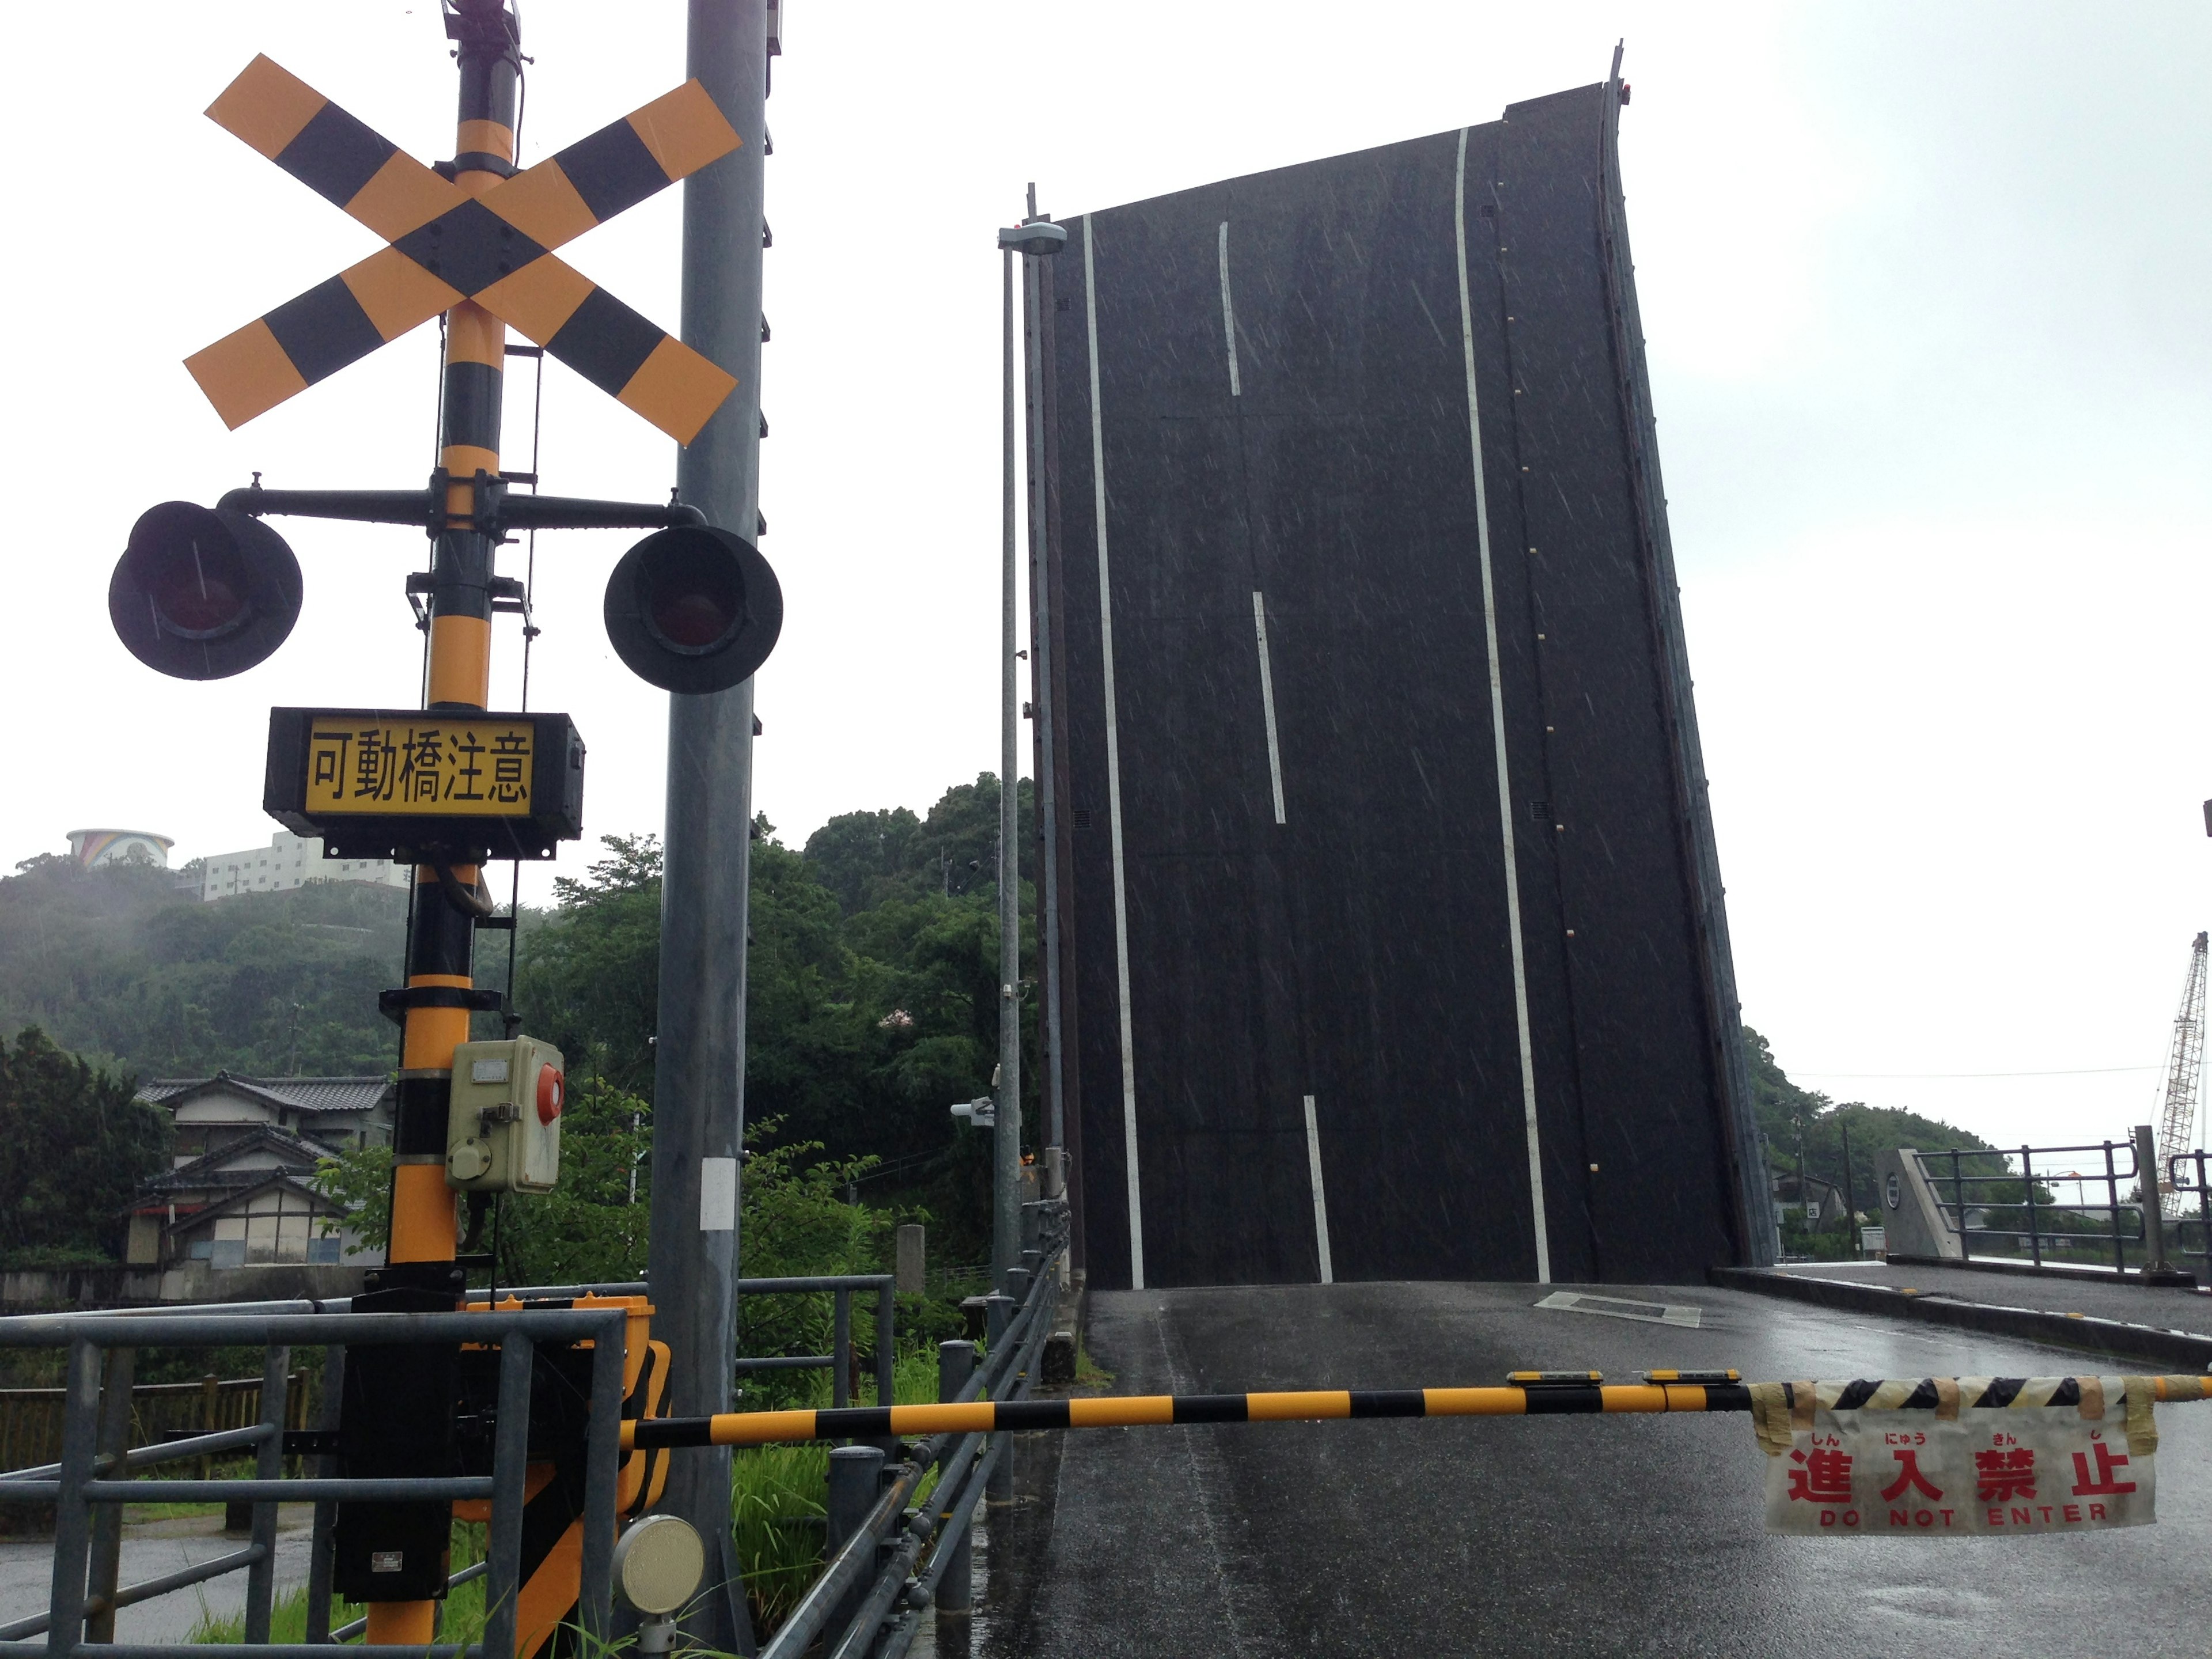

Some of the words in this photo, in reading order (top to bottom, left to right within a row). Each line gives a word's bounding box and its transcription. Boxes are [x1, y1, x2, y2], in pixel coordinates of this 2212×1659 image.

[313, 729, 530, 802] 可動橋注意
[1812, 1433, 1840, 1446] しん
[1885, 1432, 1926, 1445] にゅう
[1993, 1433, 2016, 1446] きん
[2090, 1430, 2101, 1440] し
[1787, 1443, 2136, 1502] 進入禁止
[1820, 1509, 1859, 1527] DO
[1890, 1509, 1955, 1527] NOT
[1987, 1503, 2106, 1525] ENTER
